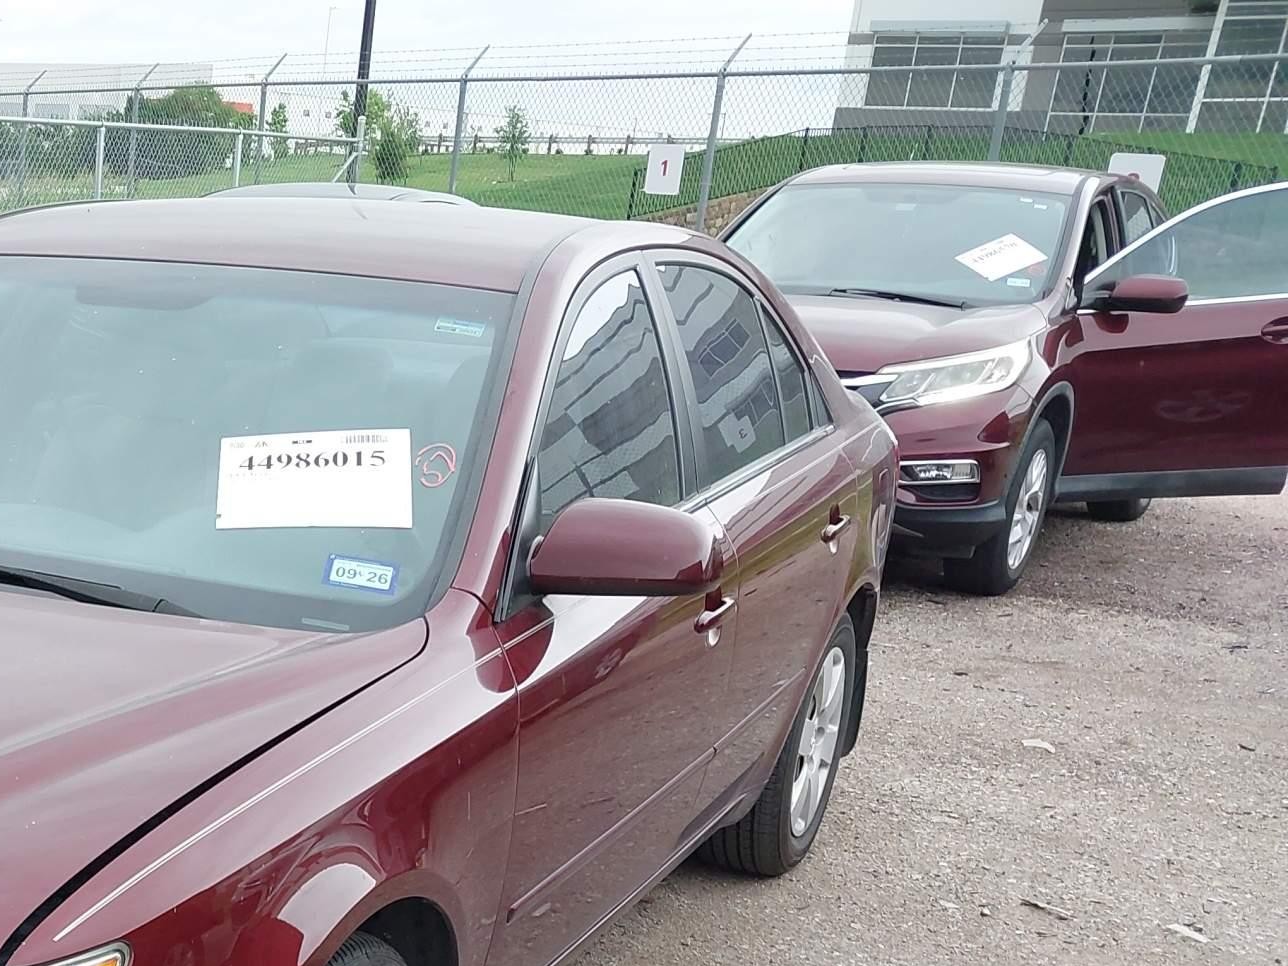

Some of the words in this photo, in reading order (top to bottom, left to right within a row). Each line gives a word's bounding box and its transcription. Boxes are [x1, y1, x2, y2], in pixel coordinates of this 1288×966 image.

[661, 160, 668, 176] 1
[239, 450, 386, 471] 44986015
[335, 566, 358, 579] 09
[366, 571, 389, 585] 26
